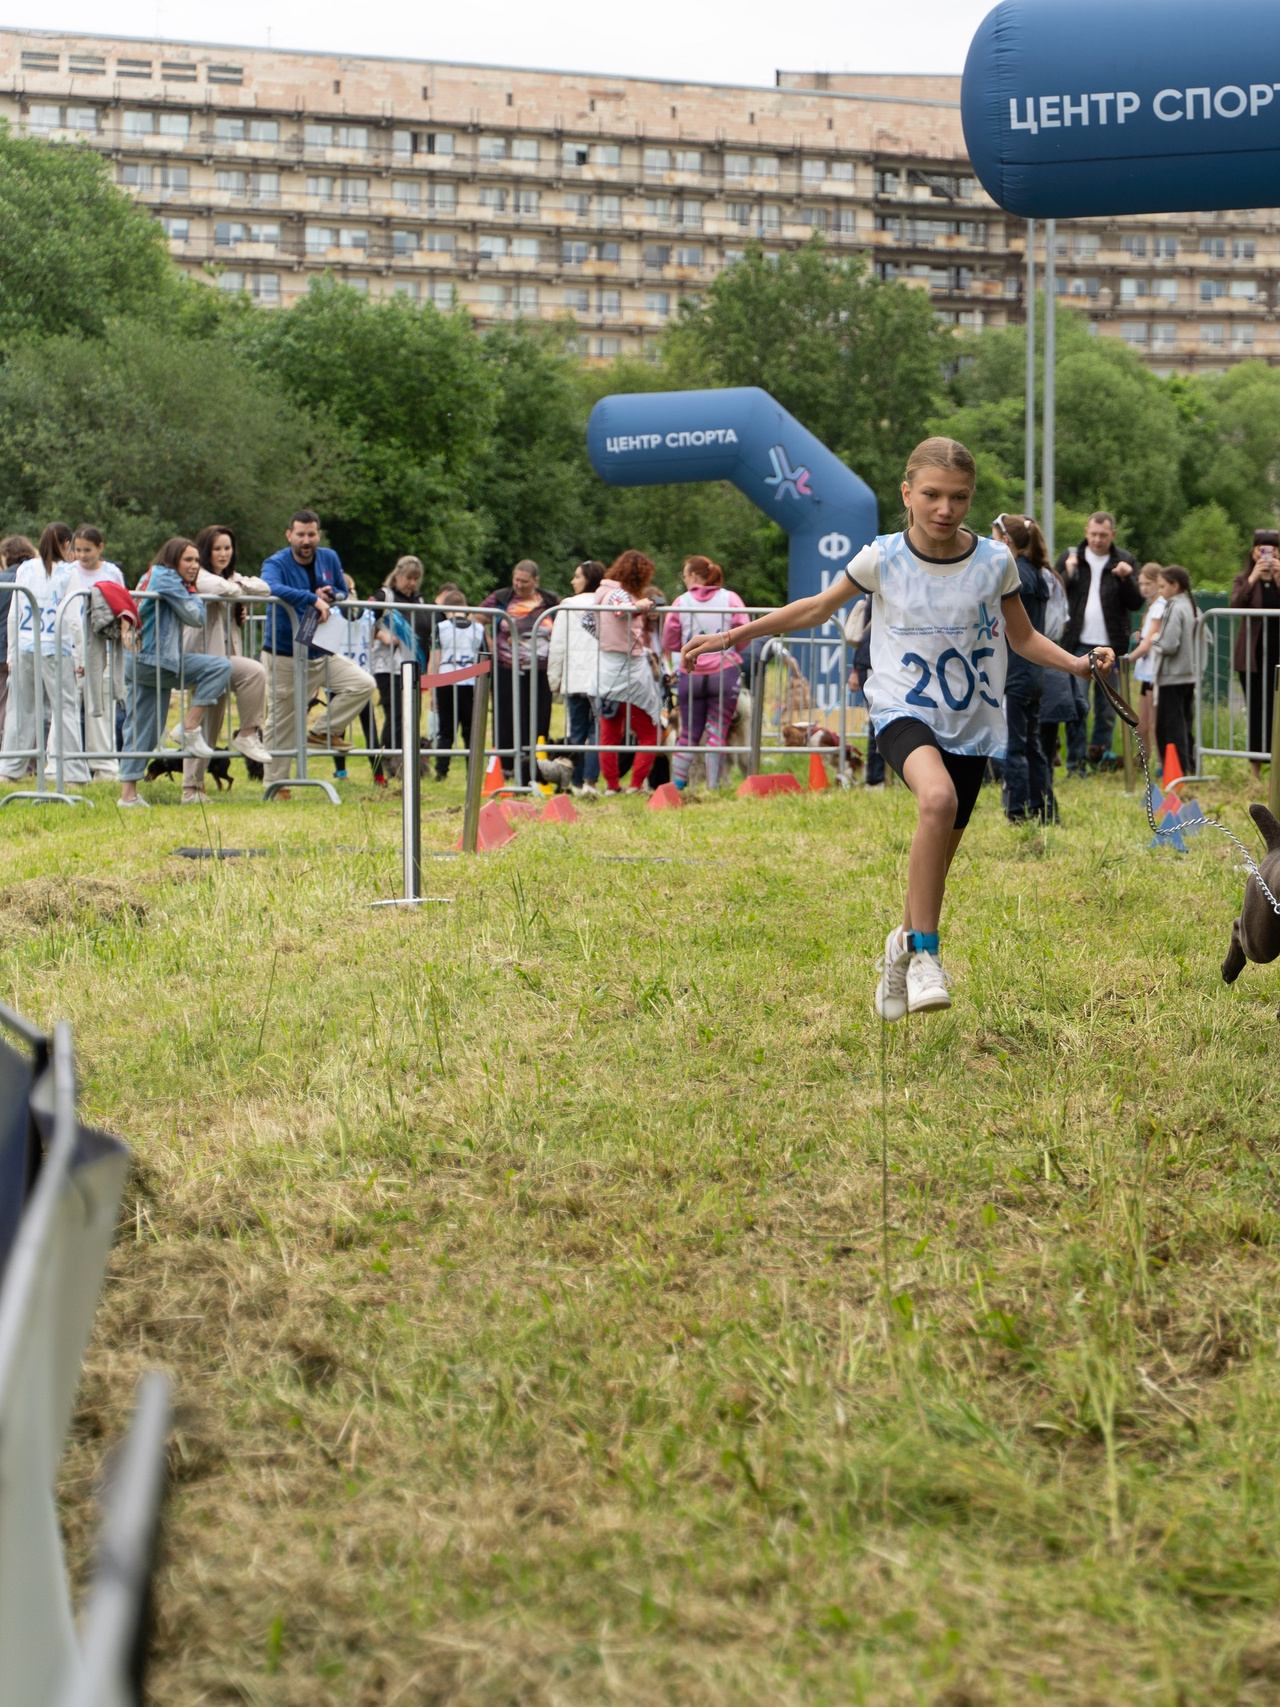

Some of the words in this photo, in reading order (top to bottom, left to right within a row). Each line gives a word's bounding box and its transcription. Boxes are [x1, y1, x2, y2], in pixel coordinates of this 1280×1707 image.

[1009, 91, 1141, 135] ЦЕНТР
[606, 433, 662, 454] ЦЕНТР
[665, 428, 739, 448] СПОРТА
[901, 647, 1000, 711] 205
